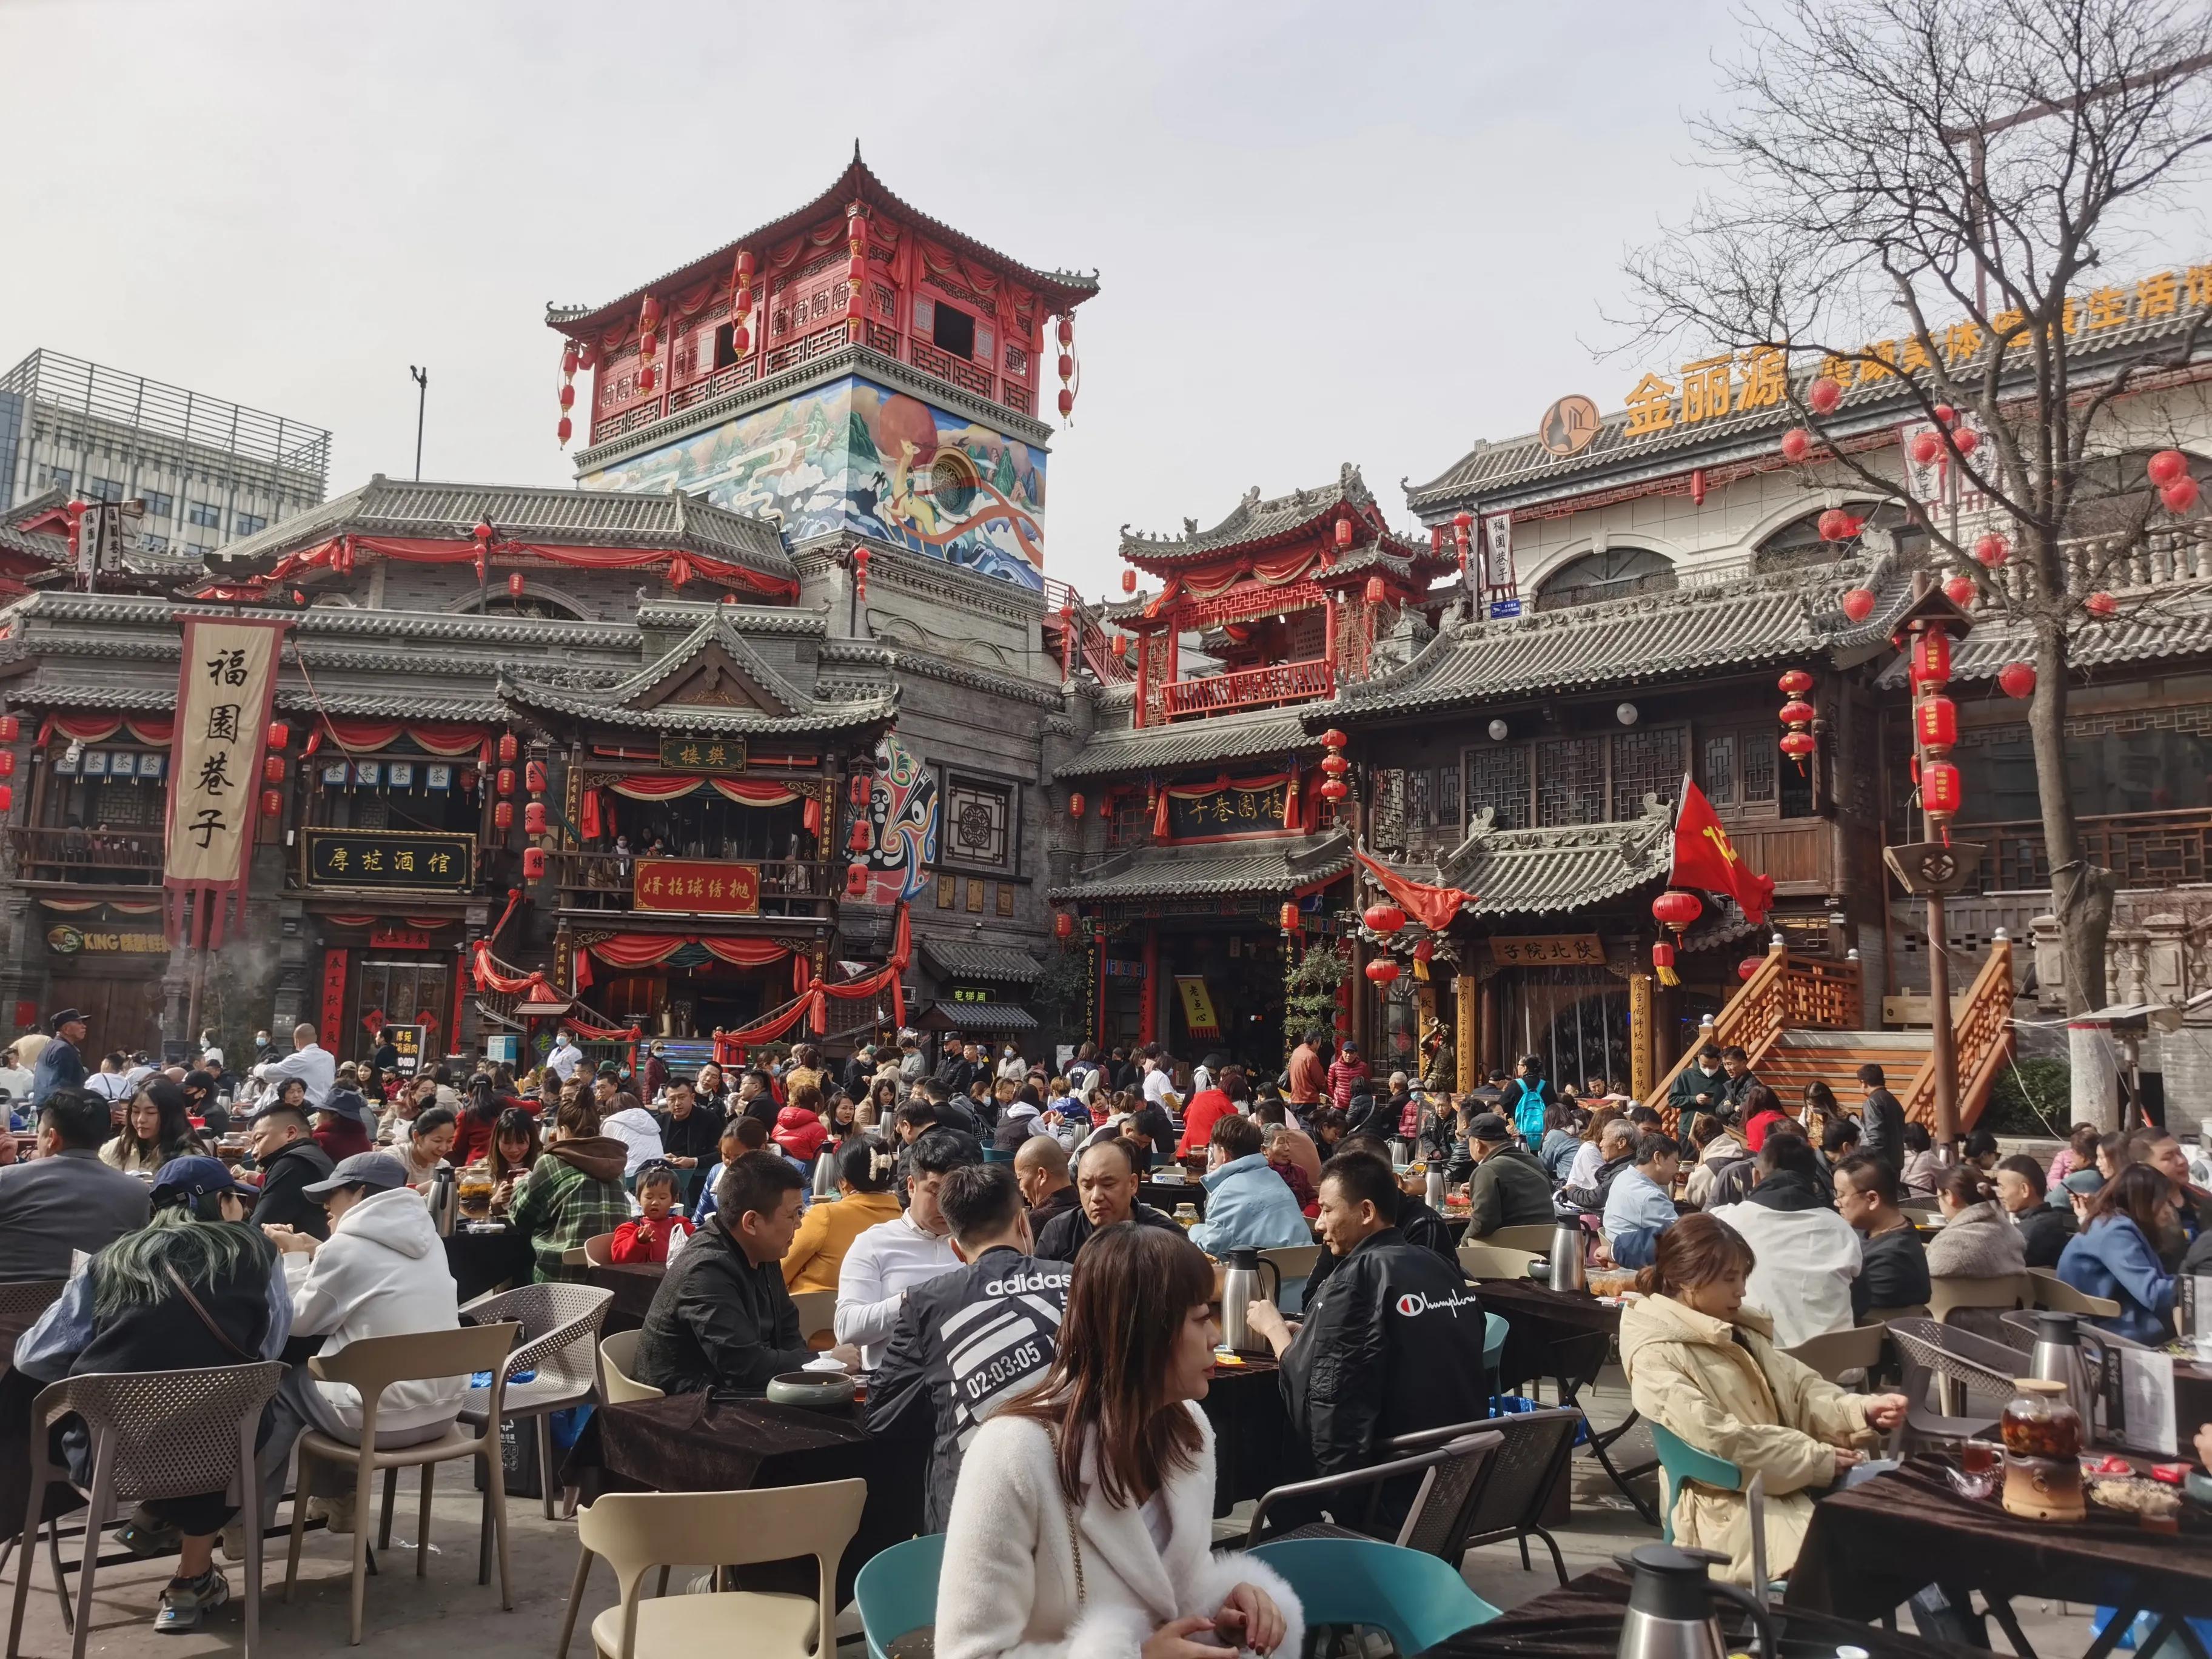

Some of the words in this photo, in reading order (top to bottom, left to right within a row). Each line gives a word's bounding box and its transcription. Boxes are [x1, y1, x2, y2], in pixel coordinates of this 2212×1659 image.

[1624, 340, 1789, 438] 金丽源
[394, 766, 408, 781] 茶
[432, 768, 446, 782] 茶
[84, 933, 119, 950] KING
[536, 1033, 552, 1051] 老
[985, 1272, 1072, 1296] adidas
[966, 1340, 1042, 1399] 02:03:05
